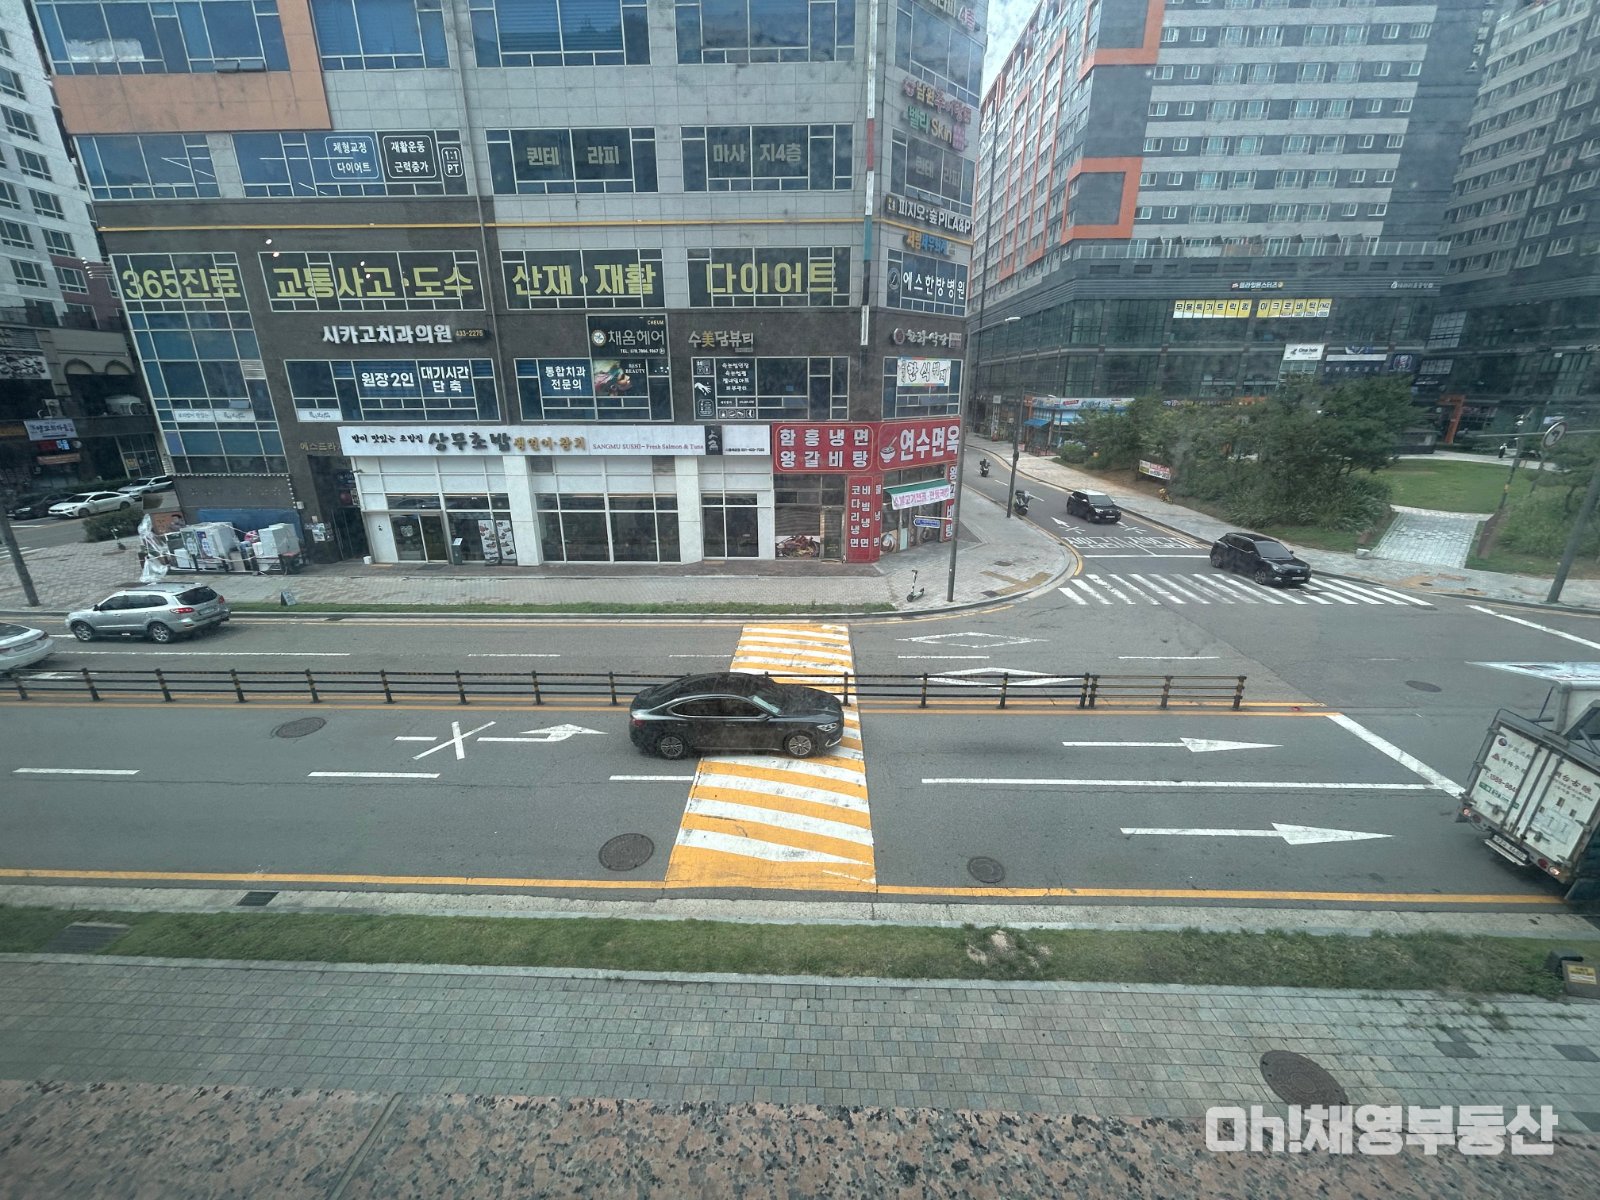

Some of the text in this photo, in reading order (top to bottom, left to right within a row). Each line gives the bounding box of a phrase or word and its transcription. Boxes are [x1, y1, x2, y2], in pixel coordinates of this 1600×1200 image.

[333, 141, 368, 154] 체형교정
[391, 141, 426, 153] 재활운동
[444, 151, 458, 160] 1:1
[337, 162, 372, 174] 다이어트
[394, 161, 429, 173] 근력증가
[448, 164, 459, 174] PT
[122, 268, 242, 299] 365진료
[706, 262, 838, 294] 다이어트
[902, 272, 966, 300] 에스한방병원
[322, 324, 453, 344] 시카고치과의원
[608, 330, 664, 346] 채움헤어
[688, 330, 754, 348] 수美담뷰티
[420, 366, 469, 380] 대기시간
[545, 366, 586, 378] 통합치과
[551, 379, 582, 391] 전문의
[352, 434, 368, 444] 밥이
[371, 434, 396, 444] 맛있는
[400, 434, 423, 443] 초밥집
[428, 432, 511, 452] 상무초밥
[780, 428, 869, 447] 함흥냉면
[900, 425, 960, 462] 연수면옥
[780, 451, 869, 468] 왕갈비탕
[850, 486, 860, 548] 코다리냉면
[860, 486, 870, 548] 비빔냉면
